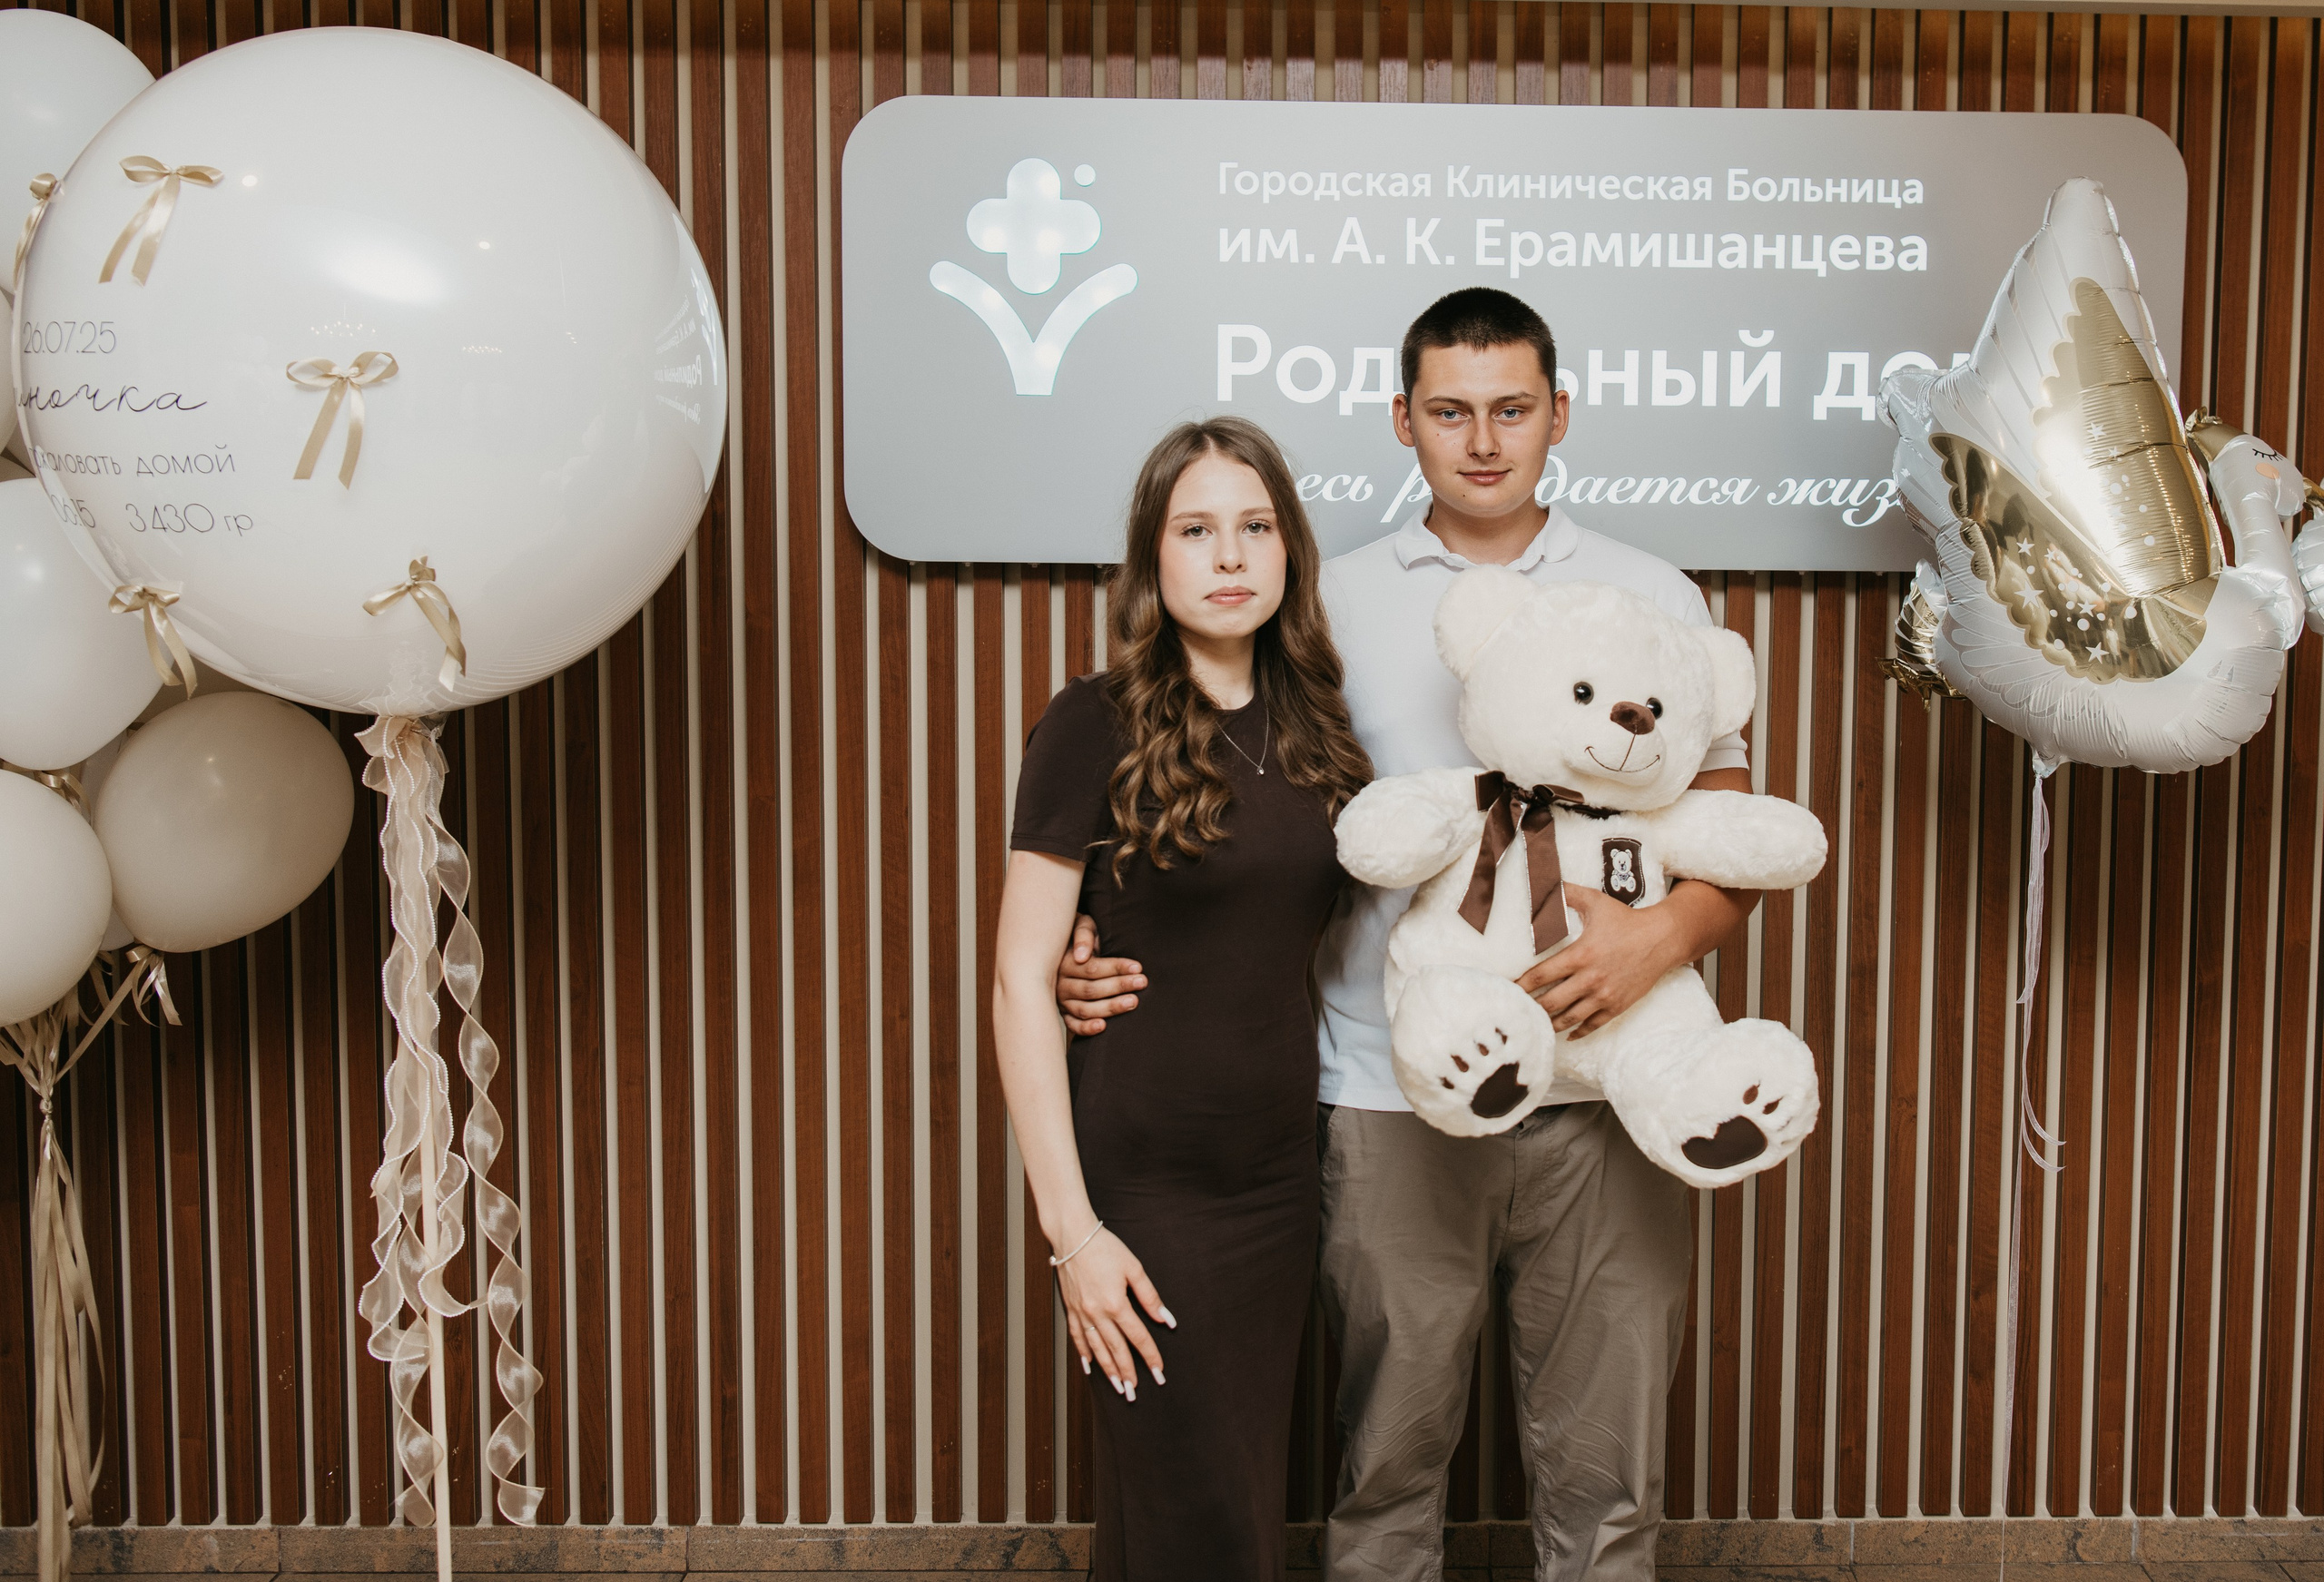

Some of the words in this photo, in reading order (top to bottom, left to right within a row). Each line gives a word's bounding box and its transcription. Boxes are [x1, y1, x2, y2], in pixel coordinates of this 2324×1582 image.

[1218, 162, 1433, 204] Городская
[1446, 164, 1713, 201] Клиническая
[1727, 168, 1925, 209] Больница
[1218, 227, 1315, 264] им.
[1331, 216, 1386, 265] А.
[1405, 217, 1456, 266] К.
[1475, 218, 1928, 279] Ерамишанцева
[23, 320, 116, 354] 26.07.25
[1216, 323, 1782, 417] Родный
[29, 447, 122, 476] ожаловать
[136, 444, 235, 477] домой
[1285, 459, 1374, 502] есь
[1380, 454, 1759, 524] рдается
[1767, 477, 1903, 527] жиз
[125, 503, 214, 533] 3430
[223, 514, 253, 536] гр
